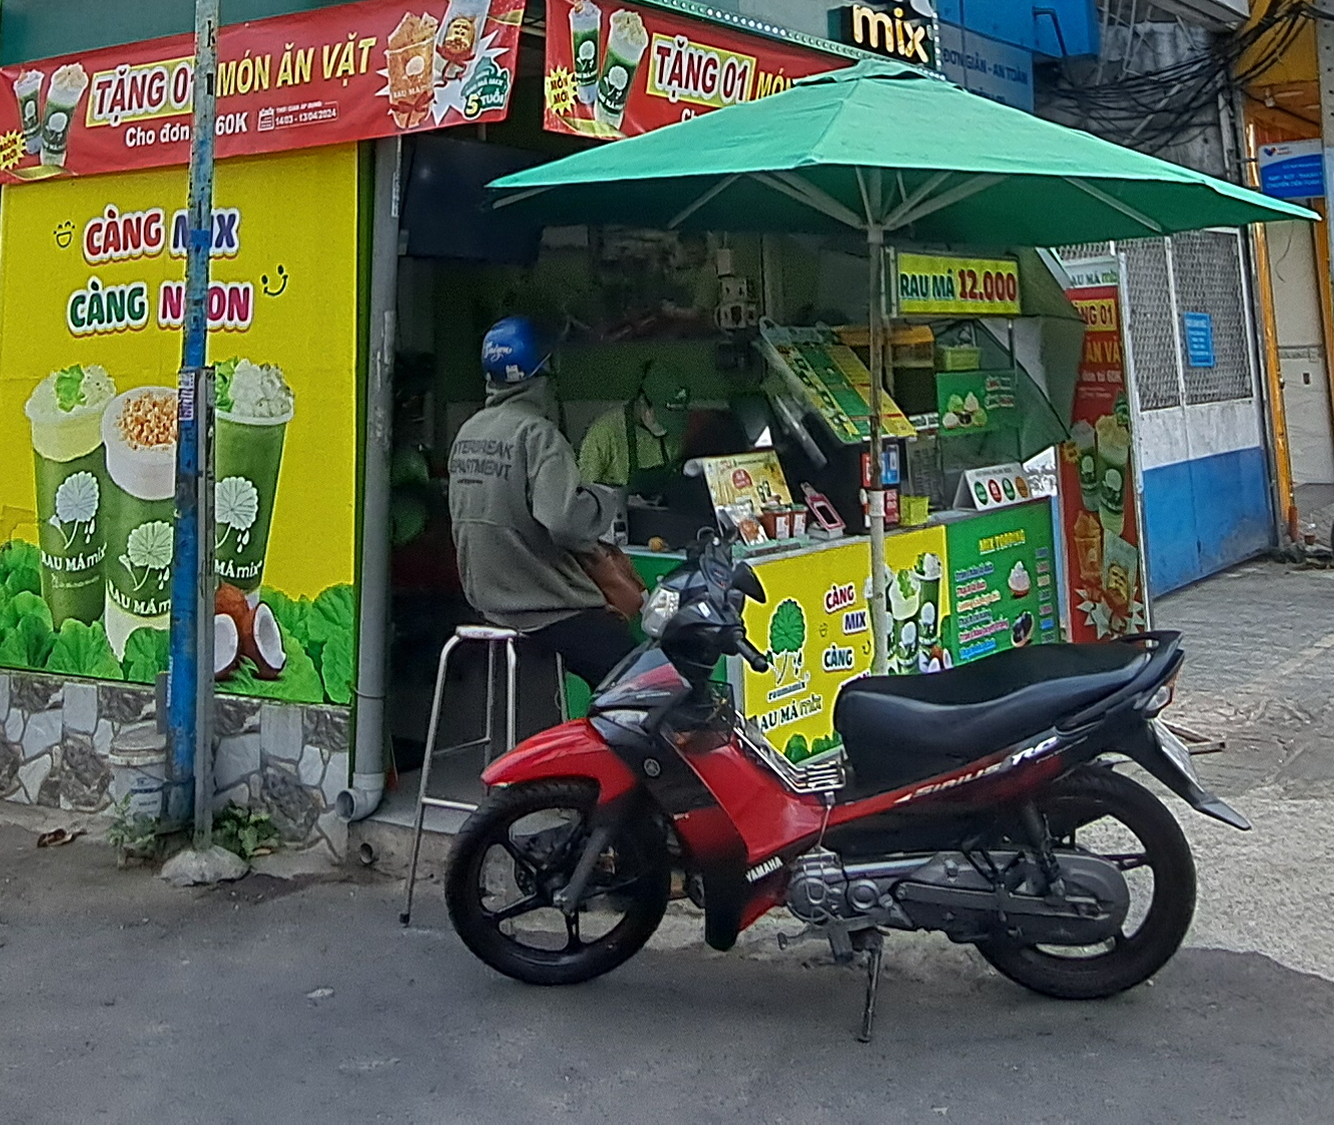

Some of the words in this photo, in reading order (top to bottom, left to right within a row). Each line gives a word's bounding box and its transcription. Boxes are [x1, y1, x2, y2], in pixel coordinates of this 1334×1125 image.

[852, 4, 930, 64] mix
[95, 69, 165, 127] TẶNG
[172, 67, 193, 106] 0
[216, 49, 272, 98] MÓN
[275, 41, 316, 89] ĂN
[322, 31, 378, 88] VẶT
[656, 38, 718, 99] TẶNG
[723, 61, 749, 102] 01
[466, 92, 480, 115] 5
[125, 125, 156, 148] Cho
[161, 122, 190, 142] đơn
[216, 112, 249, 136] 60K
[85, 205, 163, 257] CÀNG
[171, 211, 239, 253] MX
[900, 273, 929, 299] RAU
[932, 268, 956, 299] MÁ
[958, 268, 1017, 301] 12.000
[69, 279, 147, 329] CÀNG
[161, 284, 252, 325] NON
[1101, 305, 1113, 324] 01
[825, 585, 855, 610] CÀNG
[844, 610, 867, 631] MIX
[823, 644, 854, 667] CÀNG
[760, 711, 778, 731] AU
[780, 700, 799, 724] MÁ
[745, 856, 784, 883] YAMAHA
